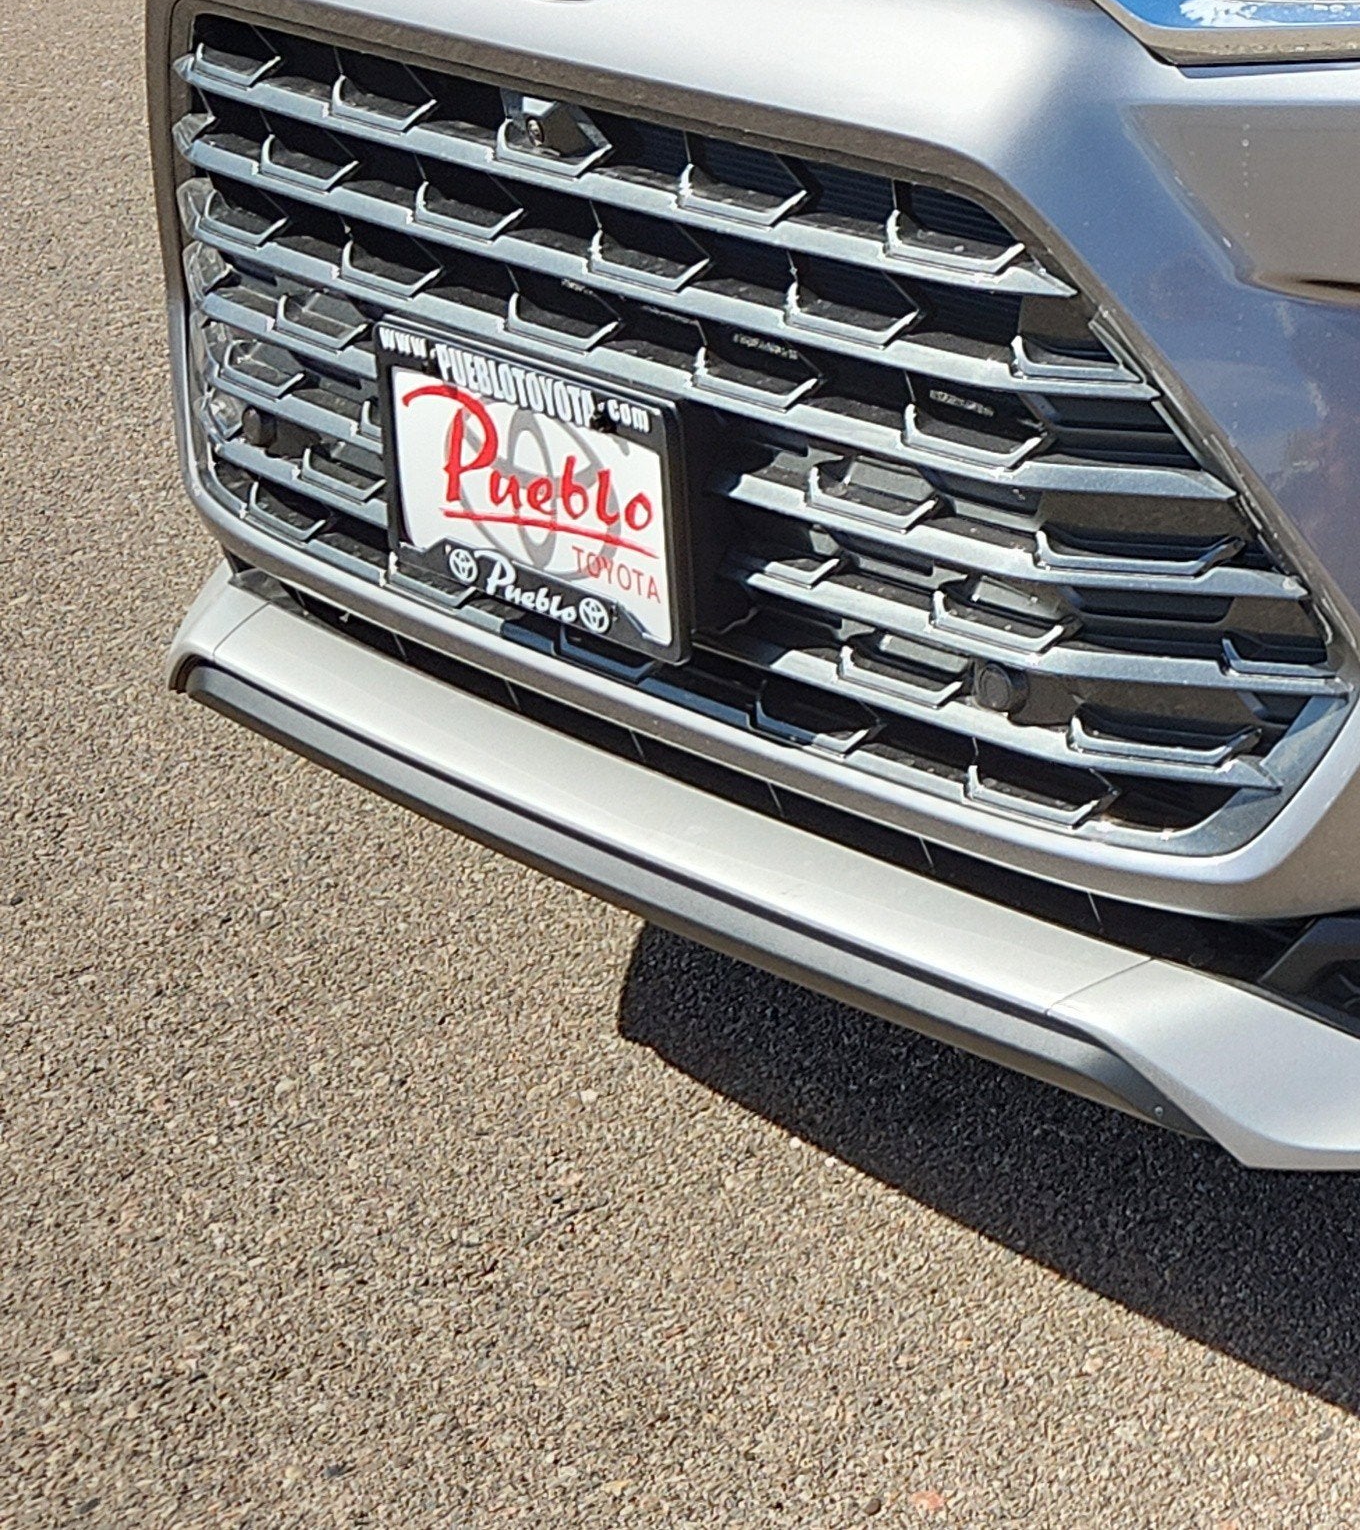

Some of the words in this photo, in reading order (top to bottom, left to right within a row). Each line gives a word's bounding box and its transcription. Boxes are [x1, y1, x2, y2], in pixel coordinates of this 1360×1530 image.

[402, 384, 654, 531] Pueblo
[472, 549, 577, 623] Pueblo
[571, 545, 662, 604] TOYOTA
